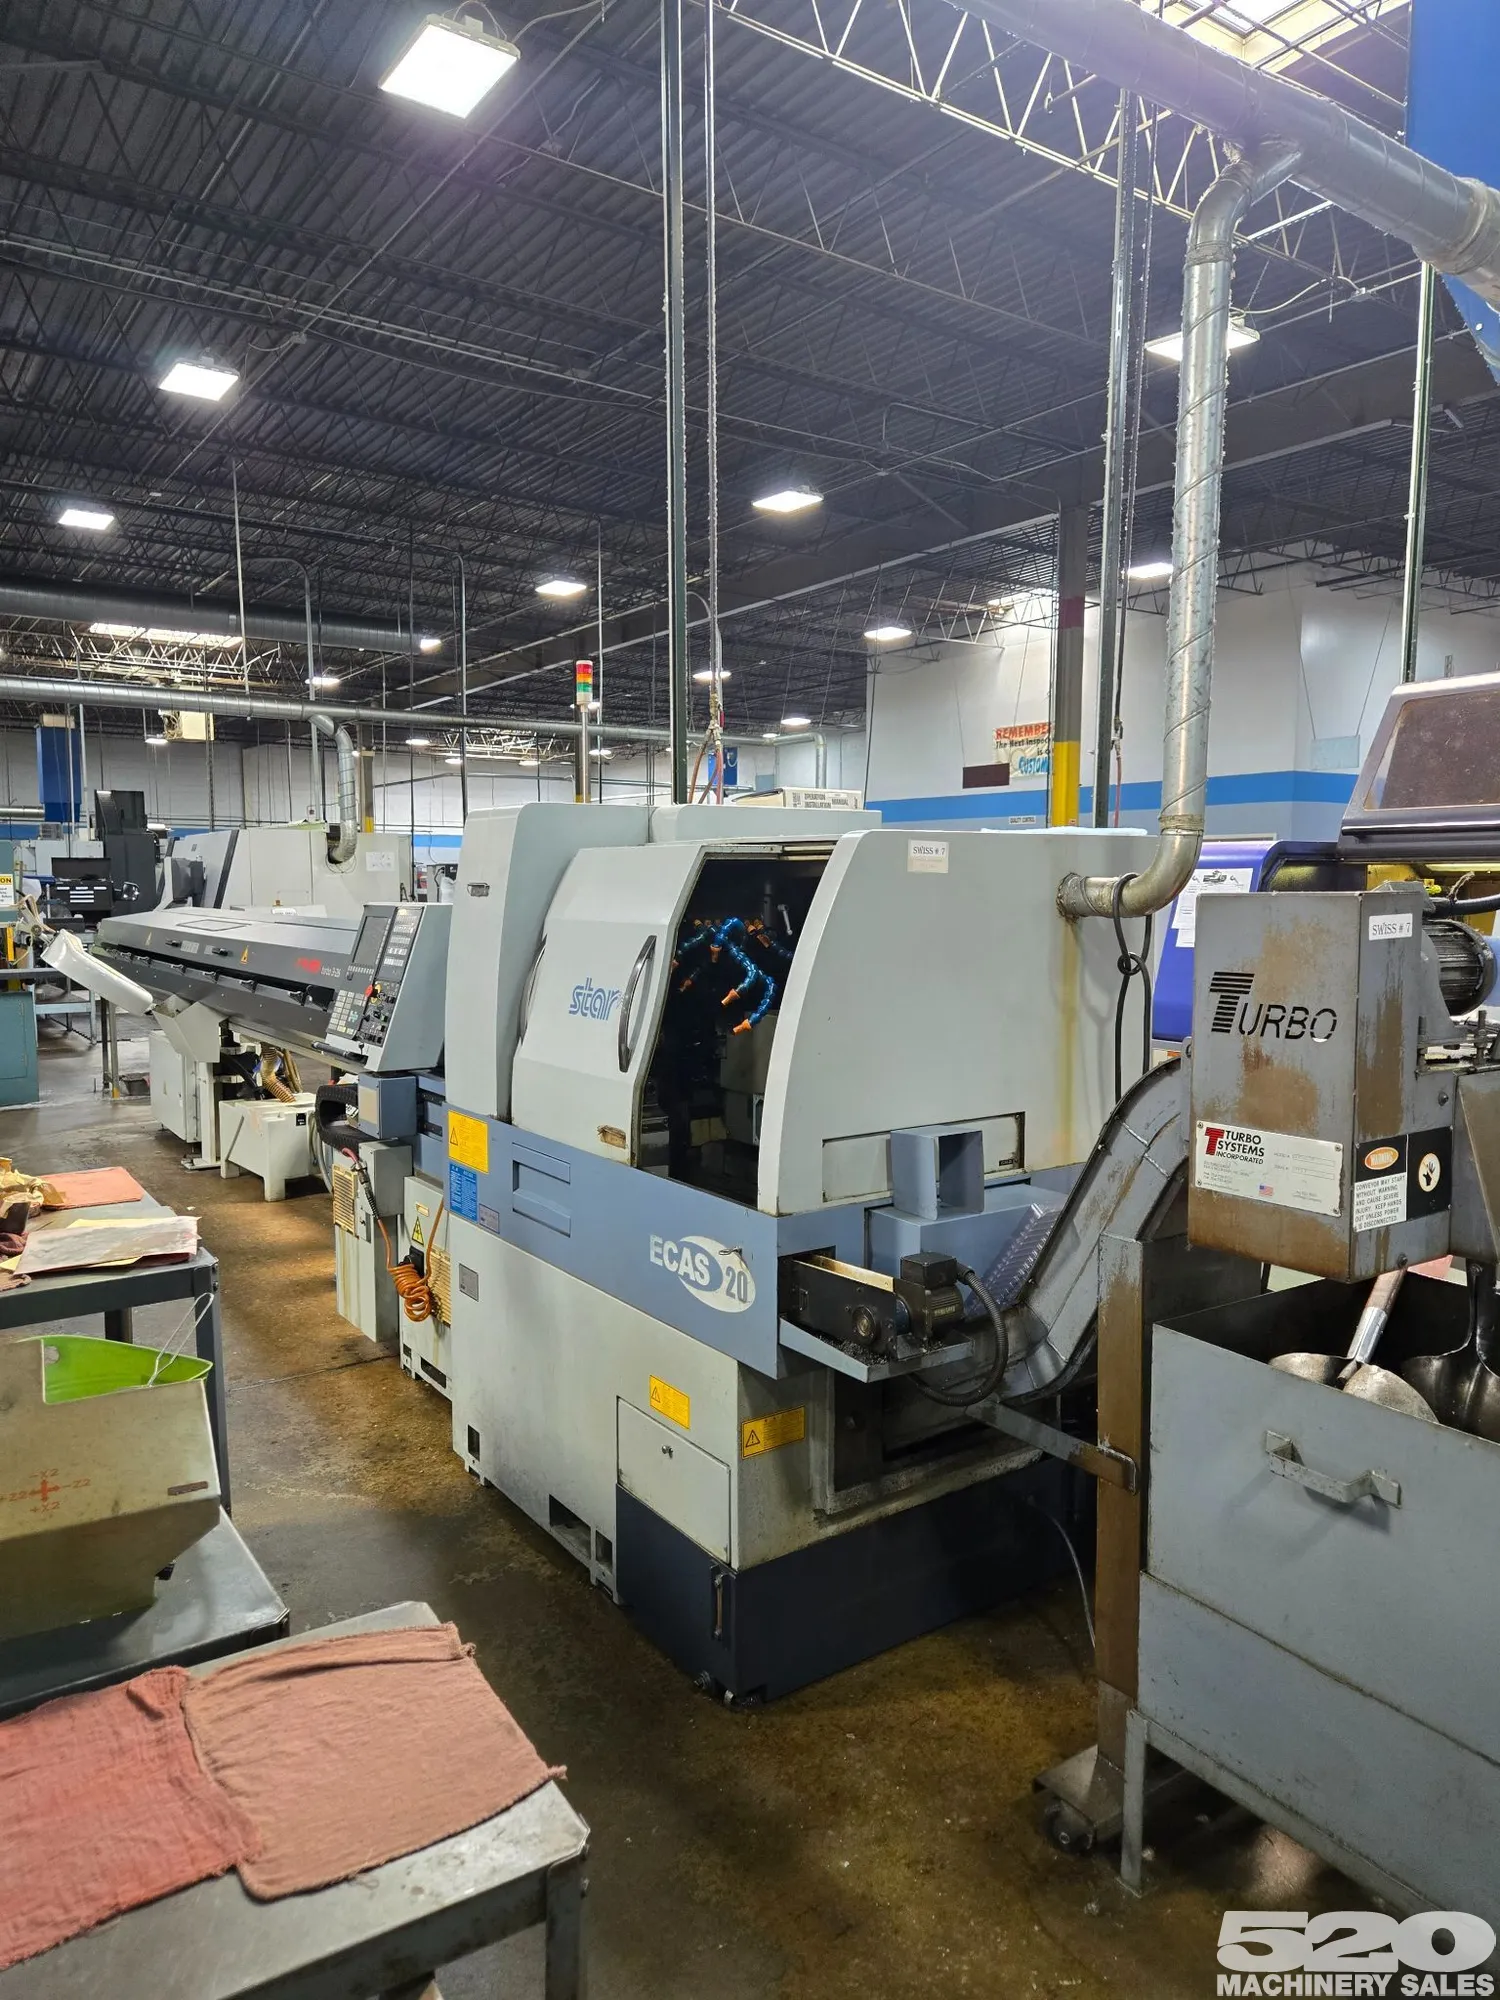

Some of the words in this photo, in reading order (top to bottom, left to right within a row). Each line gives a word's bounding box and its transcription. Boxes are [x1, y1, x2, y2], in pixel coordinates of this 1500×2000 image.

[996, 723, 1048, 740] REMEMBE
[996, 741, 1007, 749] The
[1010, 739, 1025, 747] Next
[1027, 738, 1050, 747] Inspec
[1019, 756, 1049, 774] CUSTOM
[913, 846, 934, 855] SWISS
[941, 847, 946, 855] 7
[1372, 922, 1397, 936] SWISS
[1406, 922, 1411, 933] 7
[569, 977, 622, 1020] star
[1209, 971, 1338, 1043] TURBO
[1225, 1130, 1262, 1145] TURBO
[1217, 1140, 1265, 1157] SYSTEMS
[1216, 1151, 1264, 1165] INCORPORATED
[1356, 1180, 1380, 1191] CONVEYOR
[1380, 1178, 1390, 1186] MAY
[1391, 1175, 1405, 1184] START
[1356, 1189, 1376, 1199] WITHOUT
[1378, 1184, 1398, 1193] WARNING
[1367, 1195, 1381, 1204] CAUSE
[1383, 1191, 1399, 1201] SEVERE
[1375, 1202, 1386, 1210] KEEP
[1388, 1198, 1402, 1206] HANDS
[1355, 1214, 1364, 1223] OUT
[1365, 1210, 1382, 1220] UNLESS
[1384, 1206, 1399, 1215] POWER
[649, 1235, 710, 1286] ECAS
[726, 1266, 748, 1304] 20
